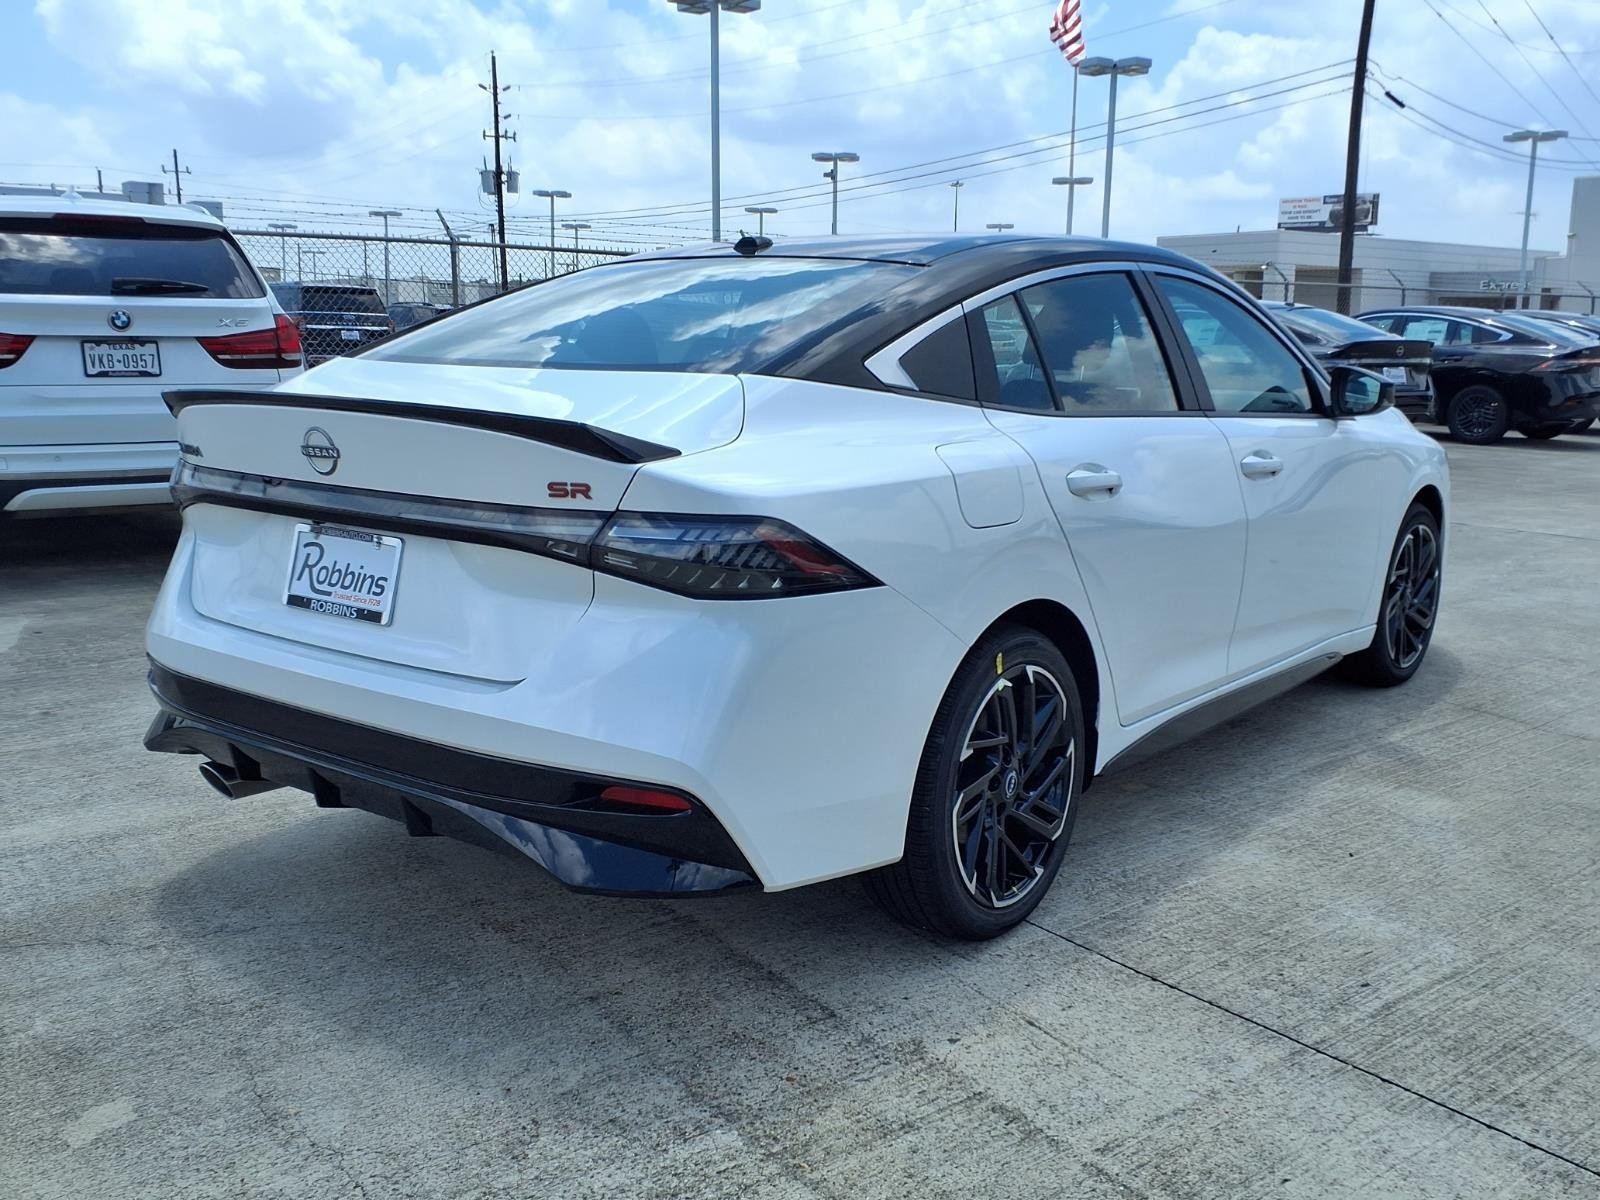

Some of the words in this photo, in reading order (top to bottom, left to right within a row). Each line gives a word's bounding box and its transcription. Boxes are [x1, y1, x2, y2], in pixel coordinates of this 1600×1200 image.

[123, 353, 155, 369] 0957
[302, 447, 338, 457] NISSAN
[546, 481, 592, 500] SR
[296, 541, 388, 597] Robbins
[332, 591, 353, 601] Trusted
[310, 600, 358, 619] ROBBINS
